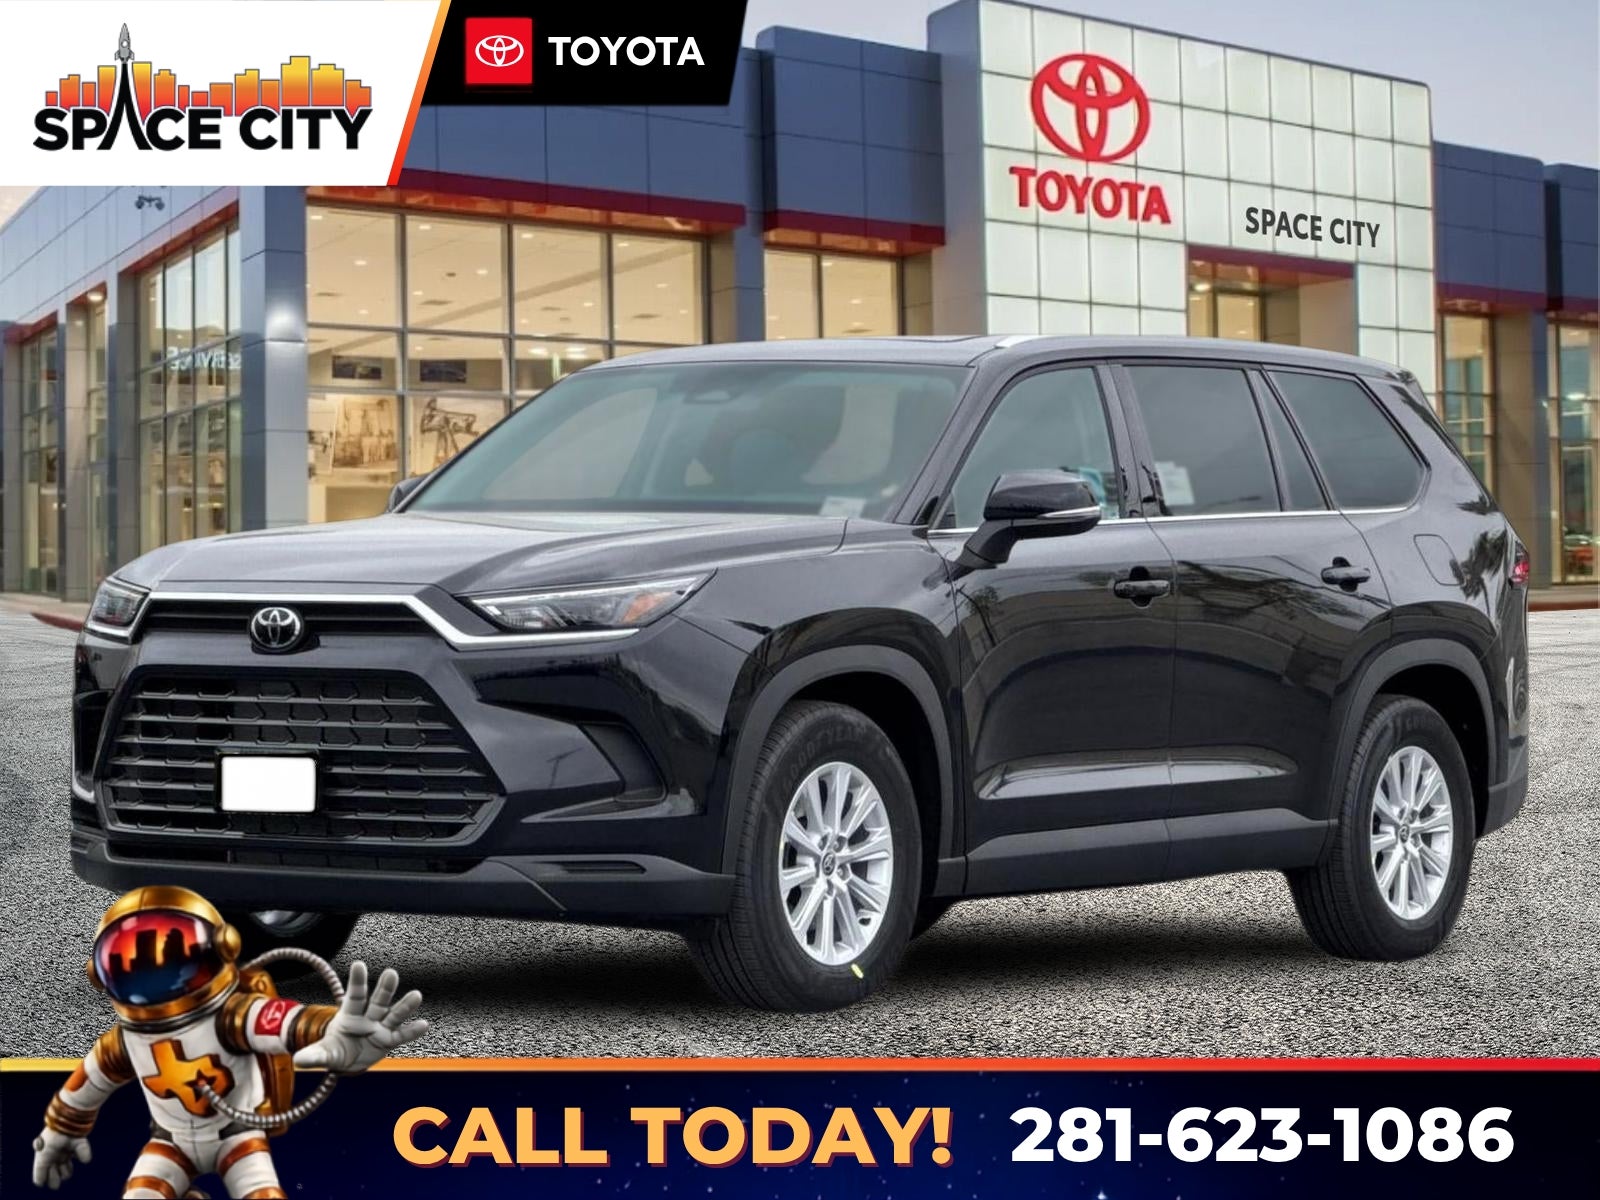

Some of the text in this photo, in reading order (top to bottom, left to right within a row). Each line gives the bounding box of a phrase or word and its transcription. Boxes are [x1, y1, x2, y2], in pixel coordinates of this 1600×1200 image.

[1009, 166, 1171, 223] TOYOTA
[1245, 207, 1381, 249] SPACE CITY
